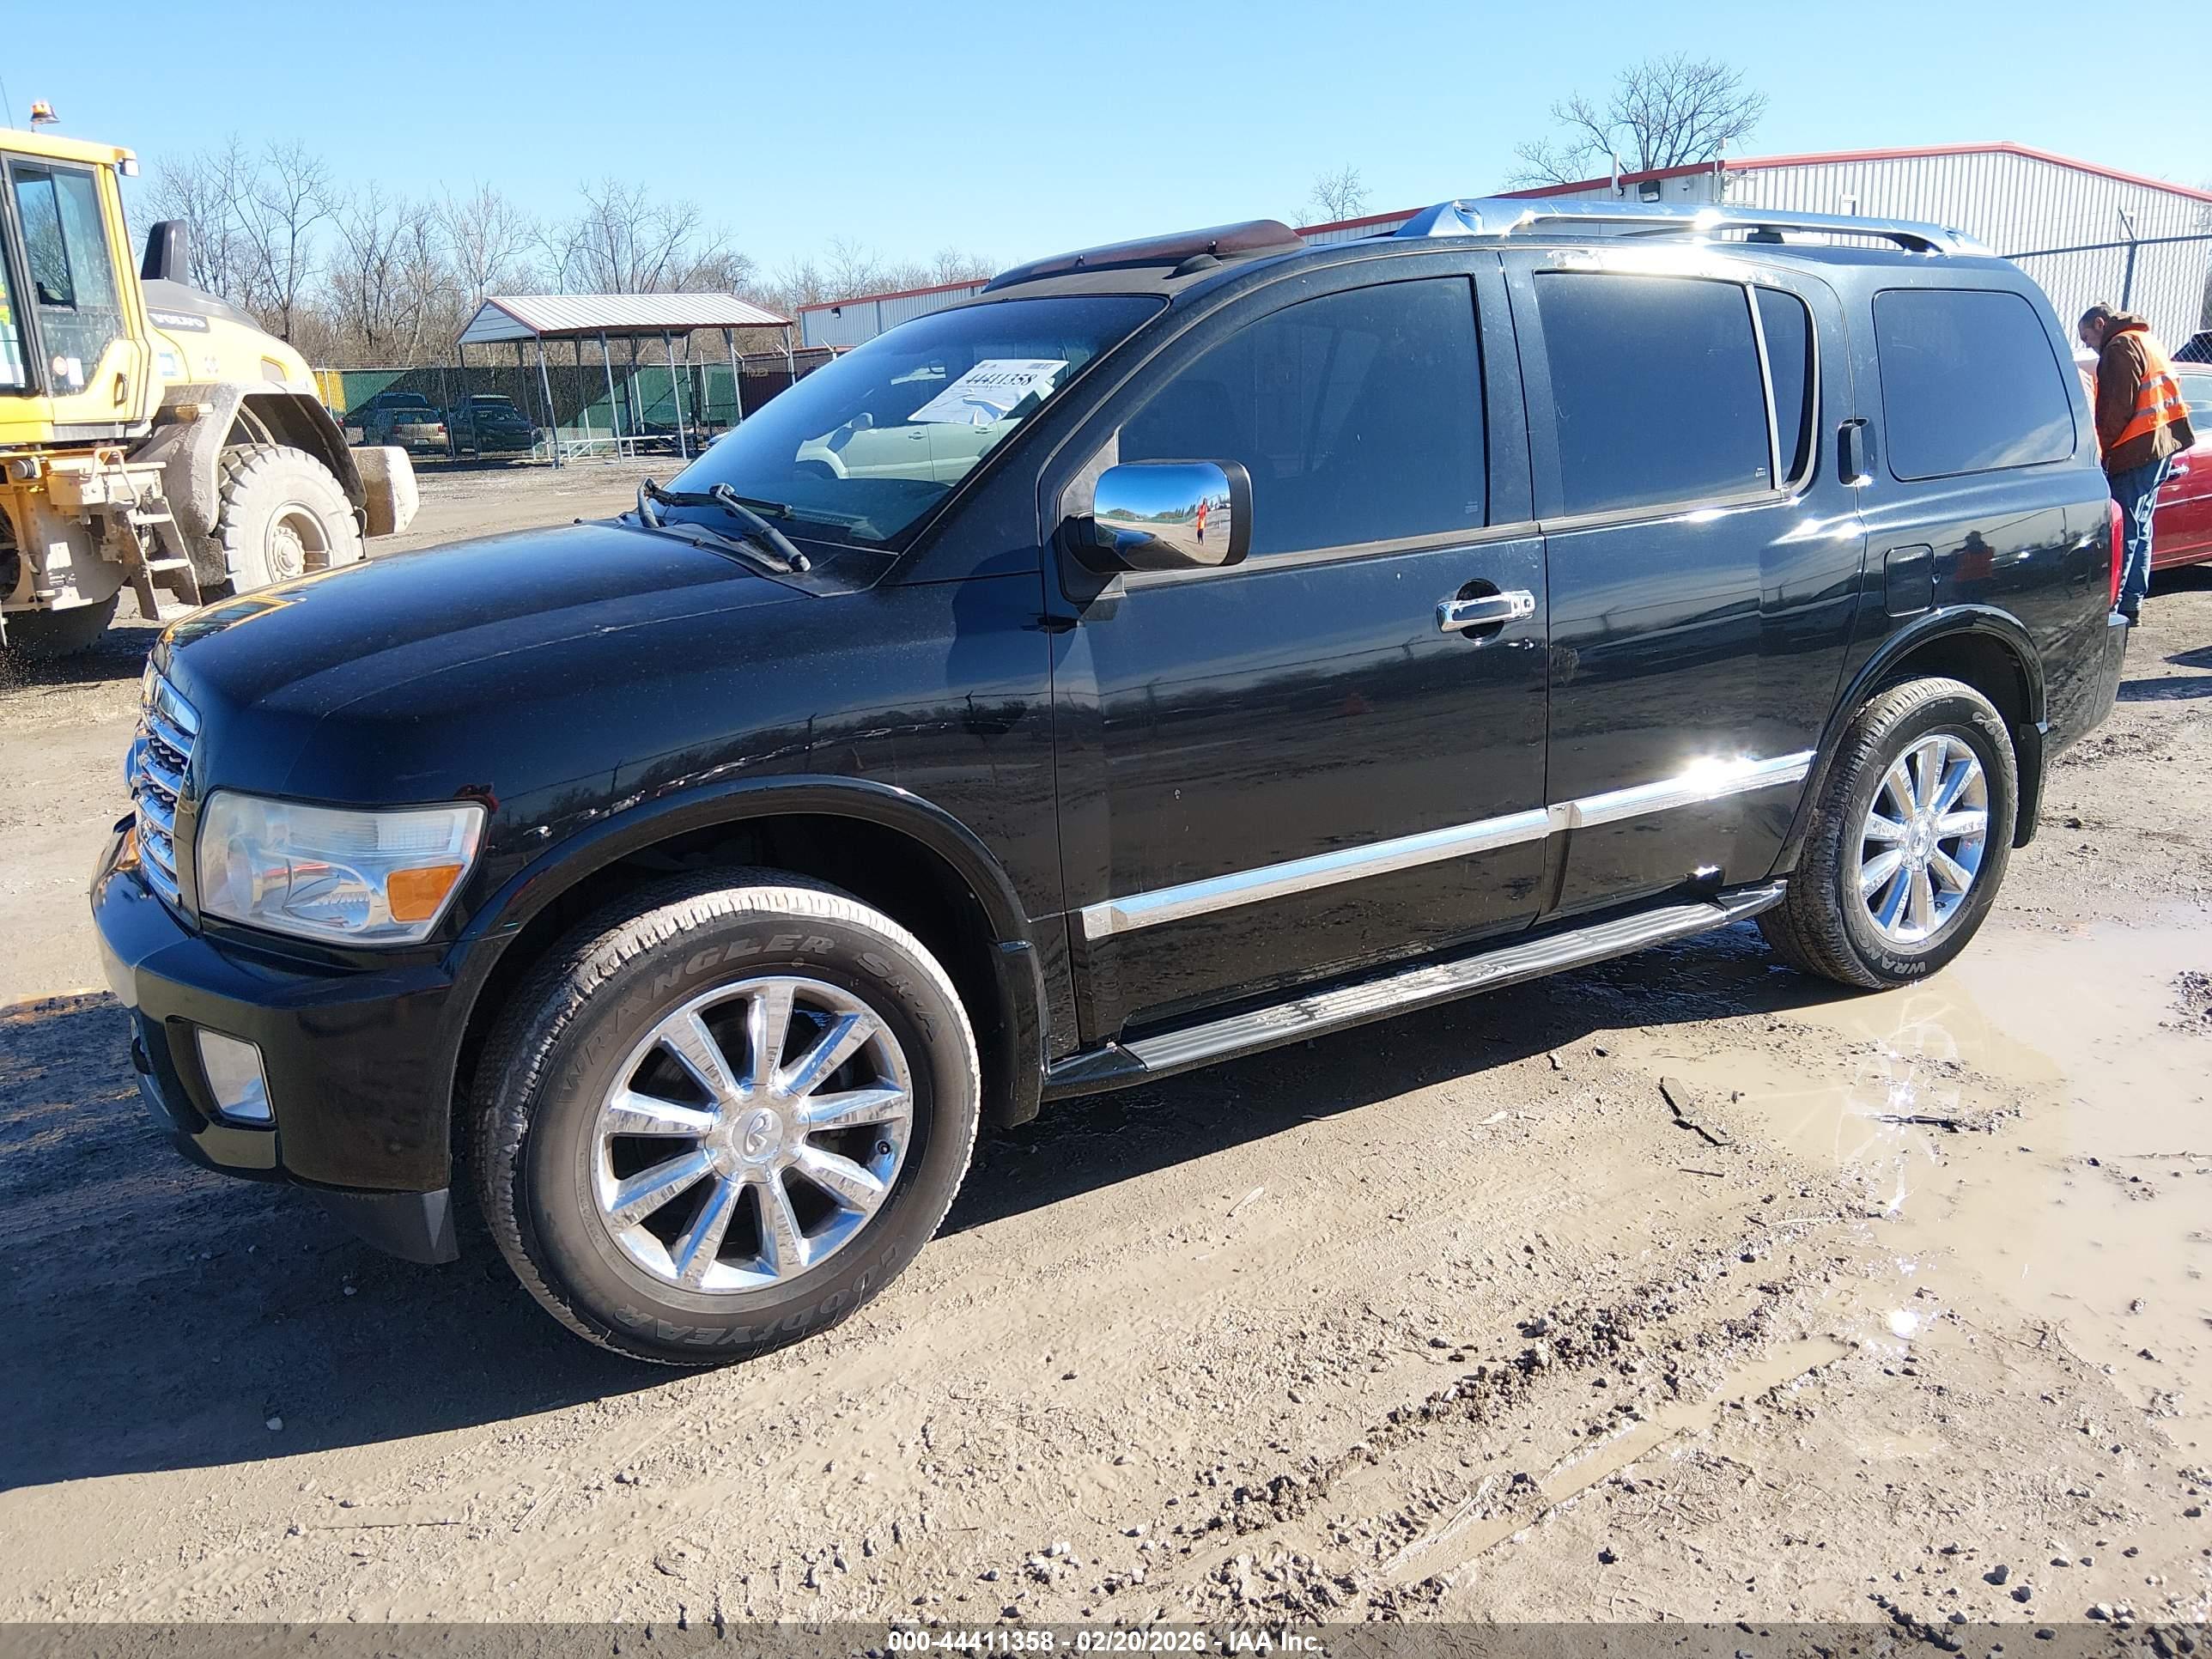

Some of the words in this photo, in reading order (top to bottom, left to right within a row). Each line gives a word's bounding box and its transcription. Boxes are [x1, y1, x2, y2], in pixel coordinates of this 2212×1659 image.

[148, 313, 206, 328] VOLVO
[966, 372, 1037, 386] 44411358
[556, 934, 835, 1105] WRANGLER
[613, 1242, 900, 1346] GOODYEAR
